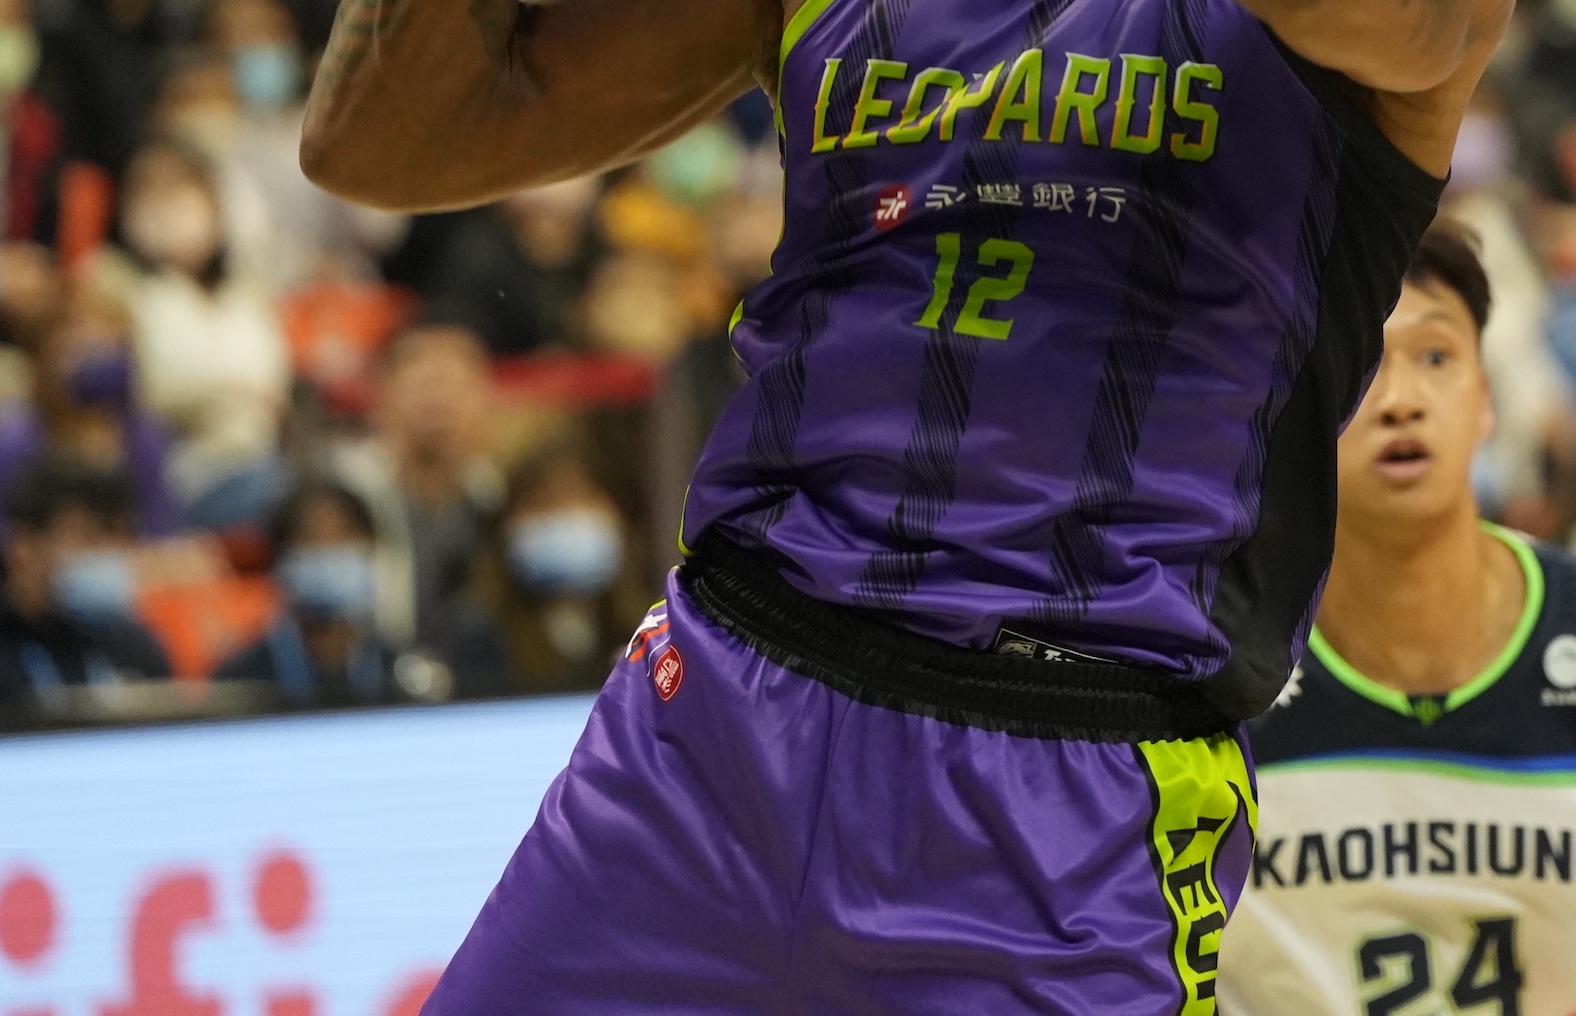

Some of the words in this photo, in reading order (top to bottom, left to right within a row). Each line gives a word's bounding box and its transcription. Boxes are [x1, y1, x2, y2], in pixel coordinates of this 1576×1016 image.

[811, 48, 1224, 163] LEOPARDS
[925, 182, 1127, 223] 永豐銀行
[912, 232, 1036, 341] 12
[1352, 915, 1525, 1016] 24
